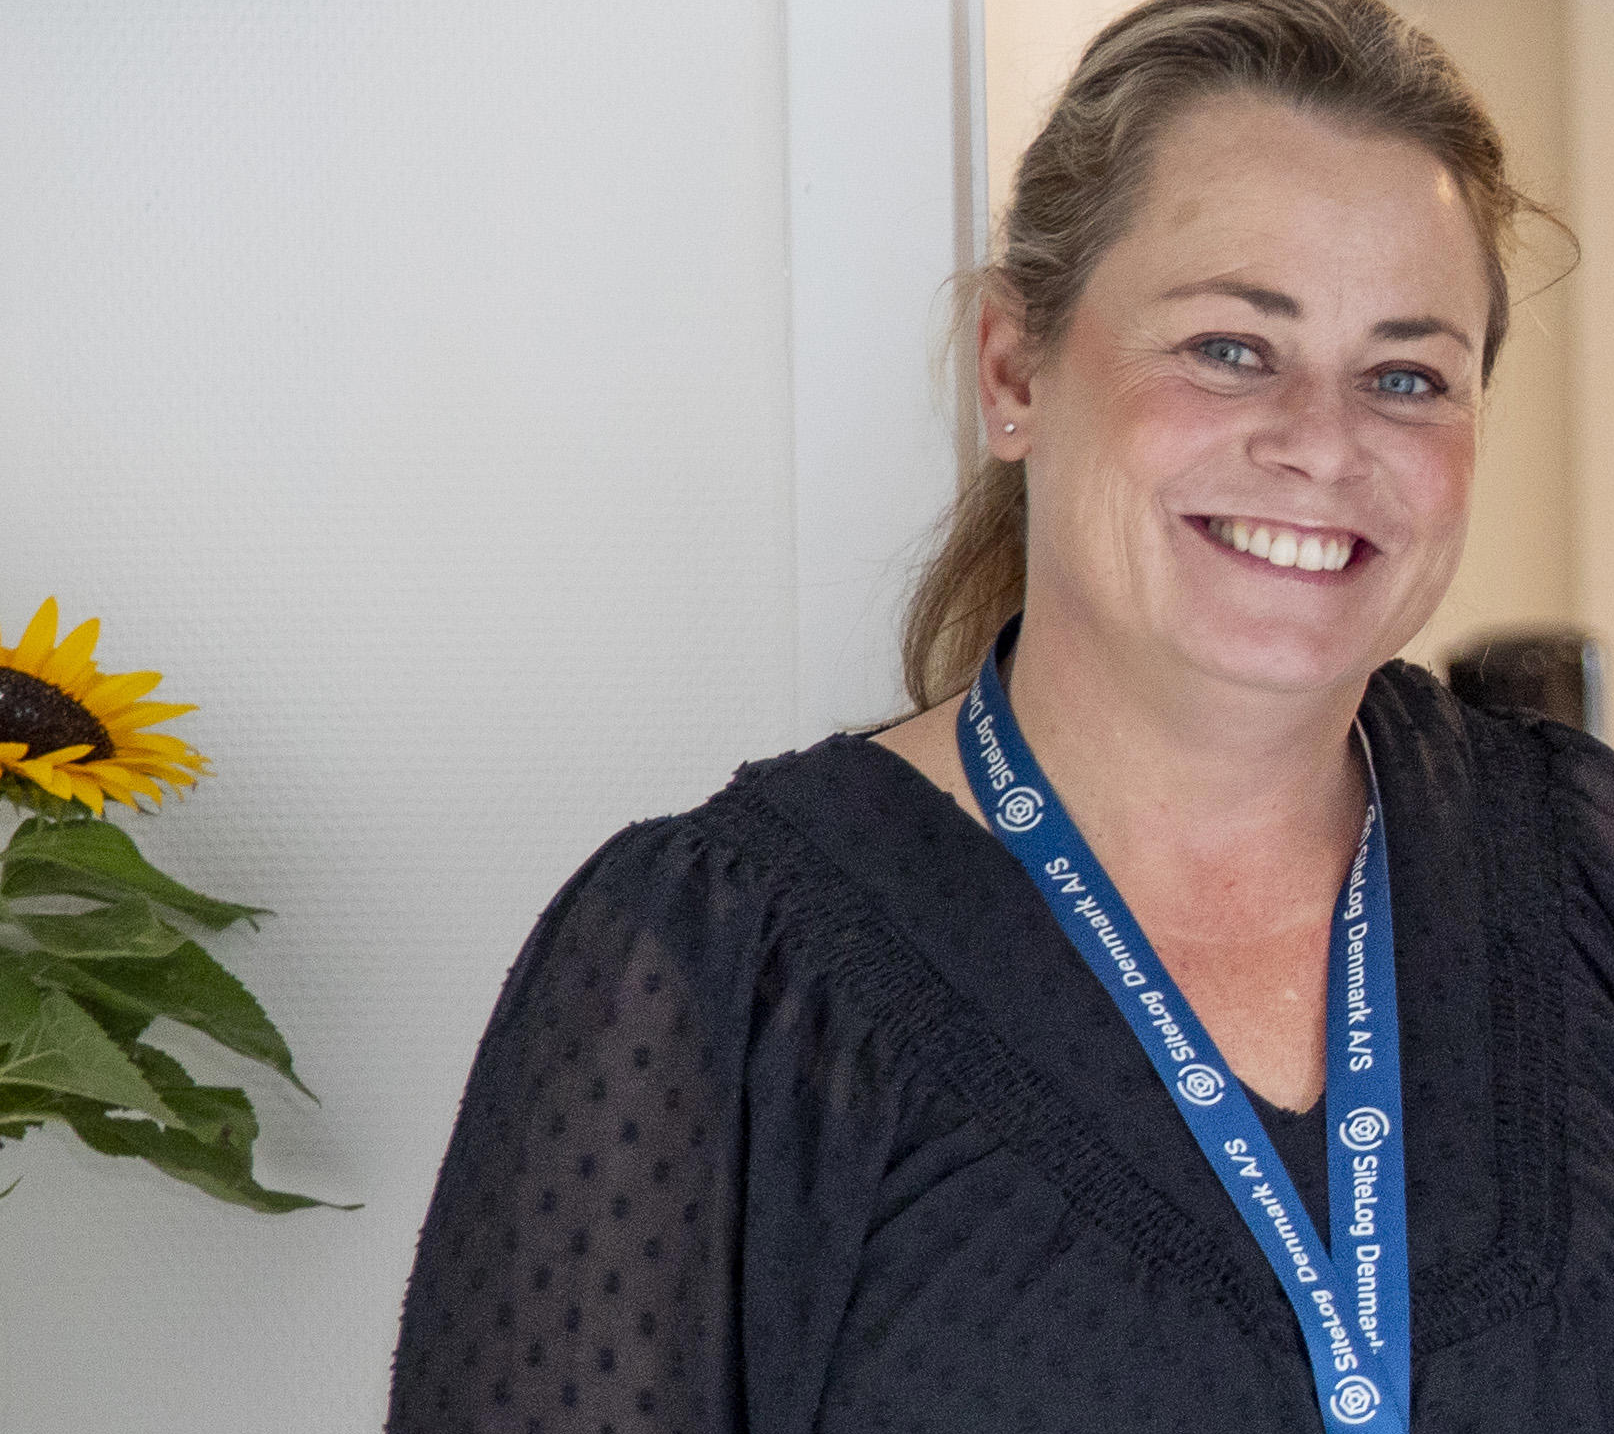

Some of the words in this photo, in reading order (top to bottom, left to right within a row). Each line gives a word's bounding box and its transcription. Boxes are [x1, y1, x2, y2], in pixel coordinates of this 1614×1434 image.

[976, 715, 1015, 791] SiteLog
[1045, 856, 1087, 894] A/S
[1343, 843, 1369, 920] SiteLog
[1073, 895, 1146, 987] Denmark
[1347, 922, 1372, 1025] Denmark
[1139, 990, 1196, 1062] SiteLog
[1348, 1030, 1373, 1072] A/S
[1224, 1138, 1263, 1178] A/S
[1349, 1155, 1378, 1236] SiteLog
[1251, 1182, 1318, 1283] Denmark
[1311, 1289, 1358, 1372] SiteLog
